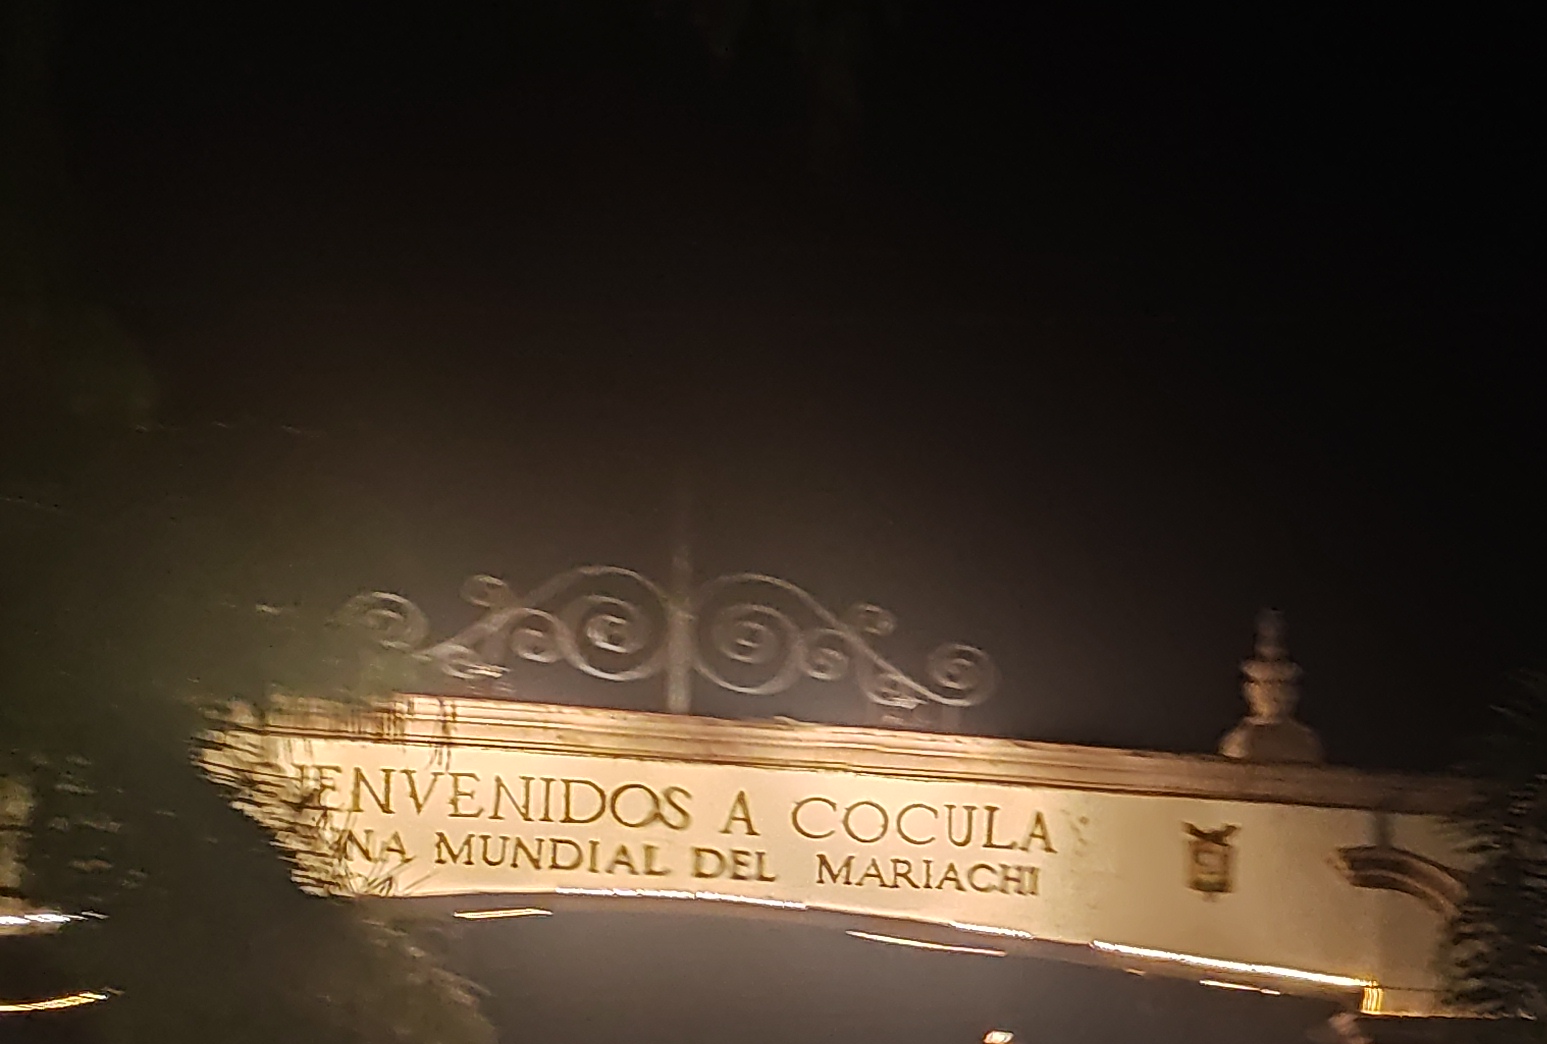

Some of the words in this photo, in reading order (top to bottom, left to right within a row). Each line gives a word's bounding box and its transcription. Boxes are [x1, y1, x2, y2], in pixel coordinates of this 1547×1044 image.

[294, 764, 693, 831] IENVENIDOS
[719, 790, 761, 836] A
[791, 797, 1058, 854] COCULA
[435, 831, 671, 876] MUNDIAL
[691, 846, 776, 883] DEL
[816, 853, 1042, 896] MARIACHI
